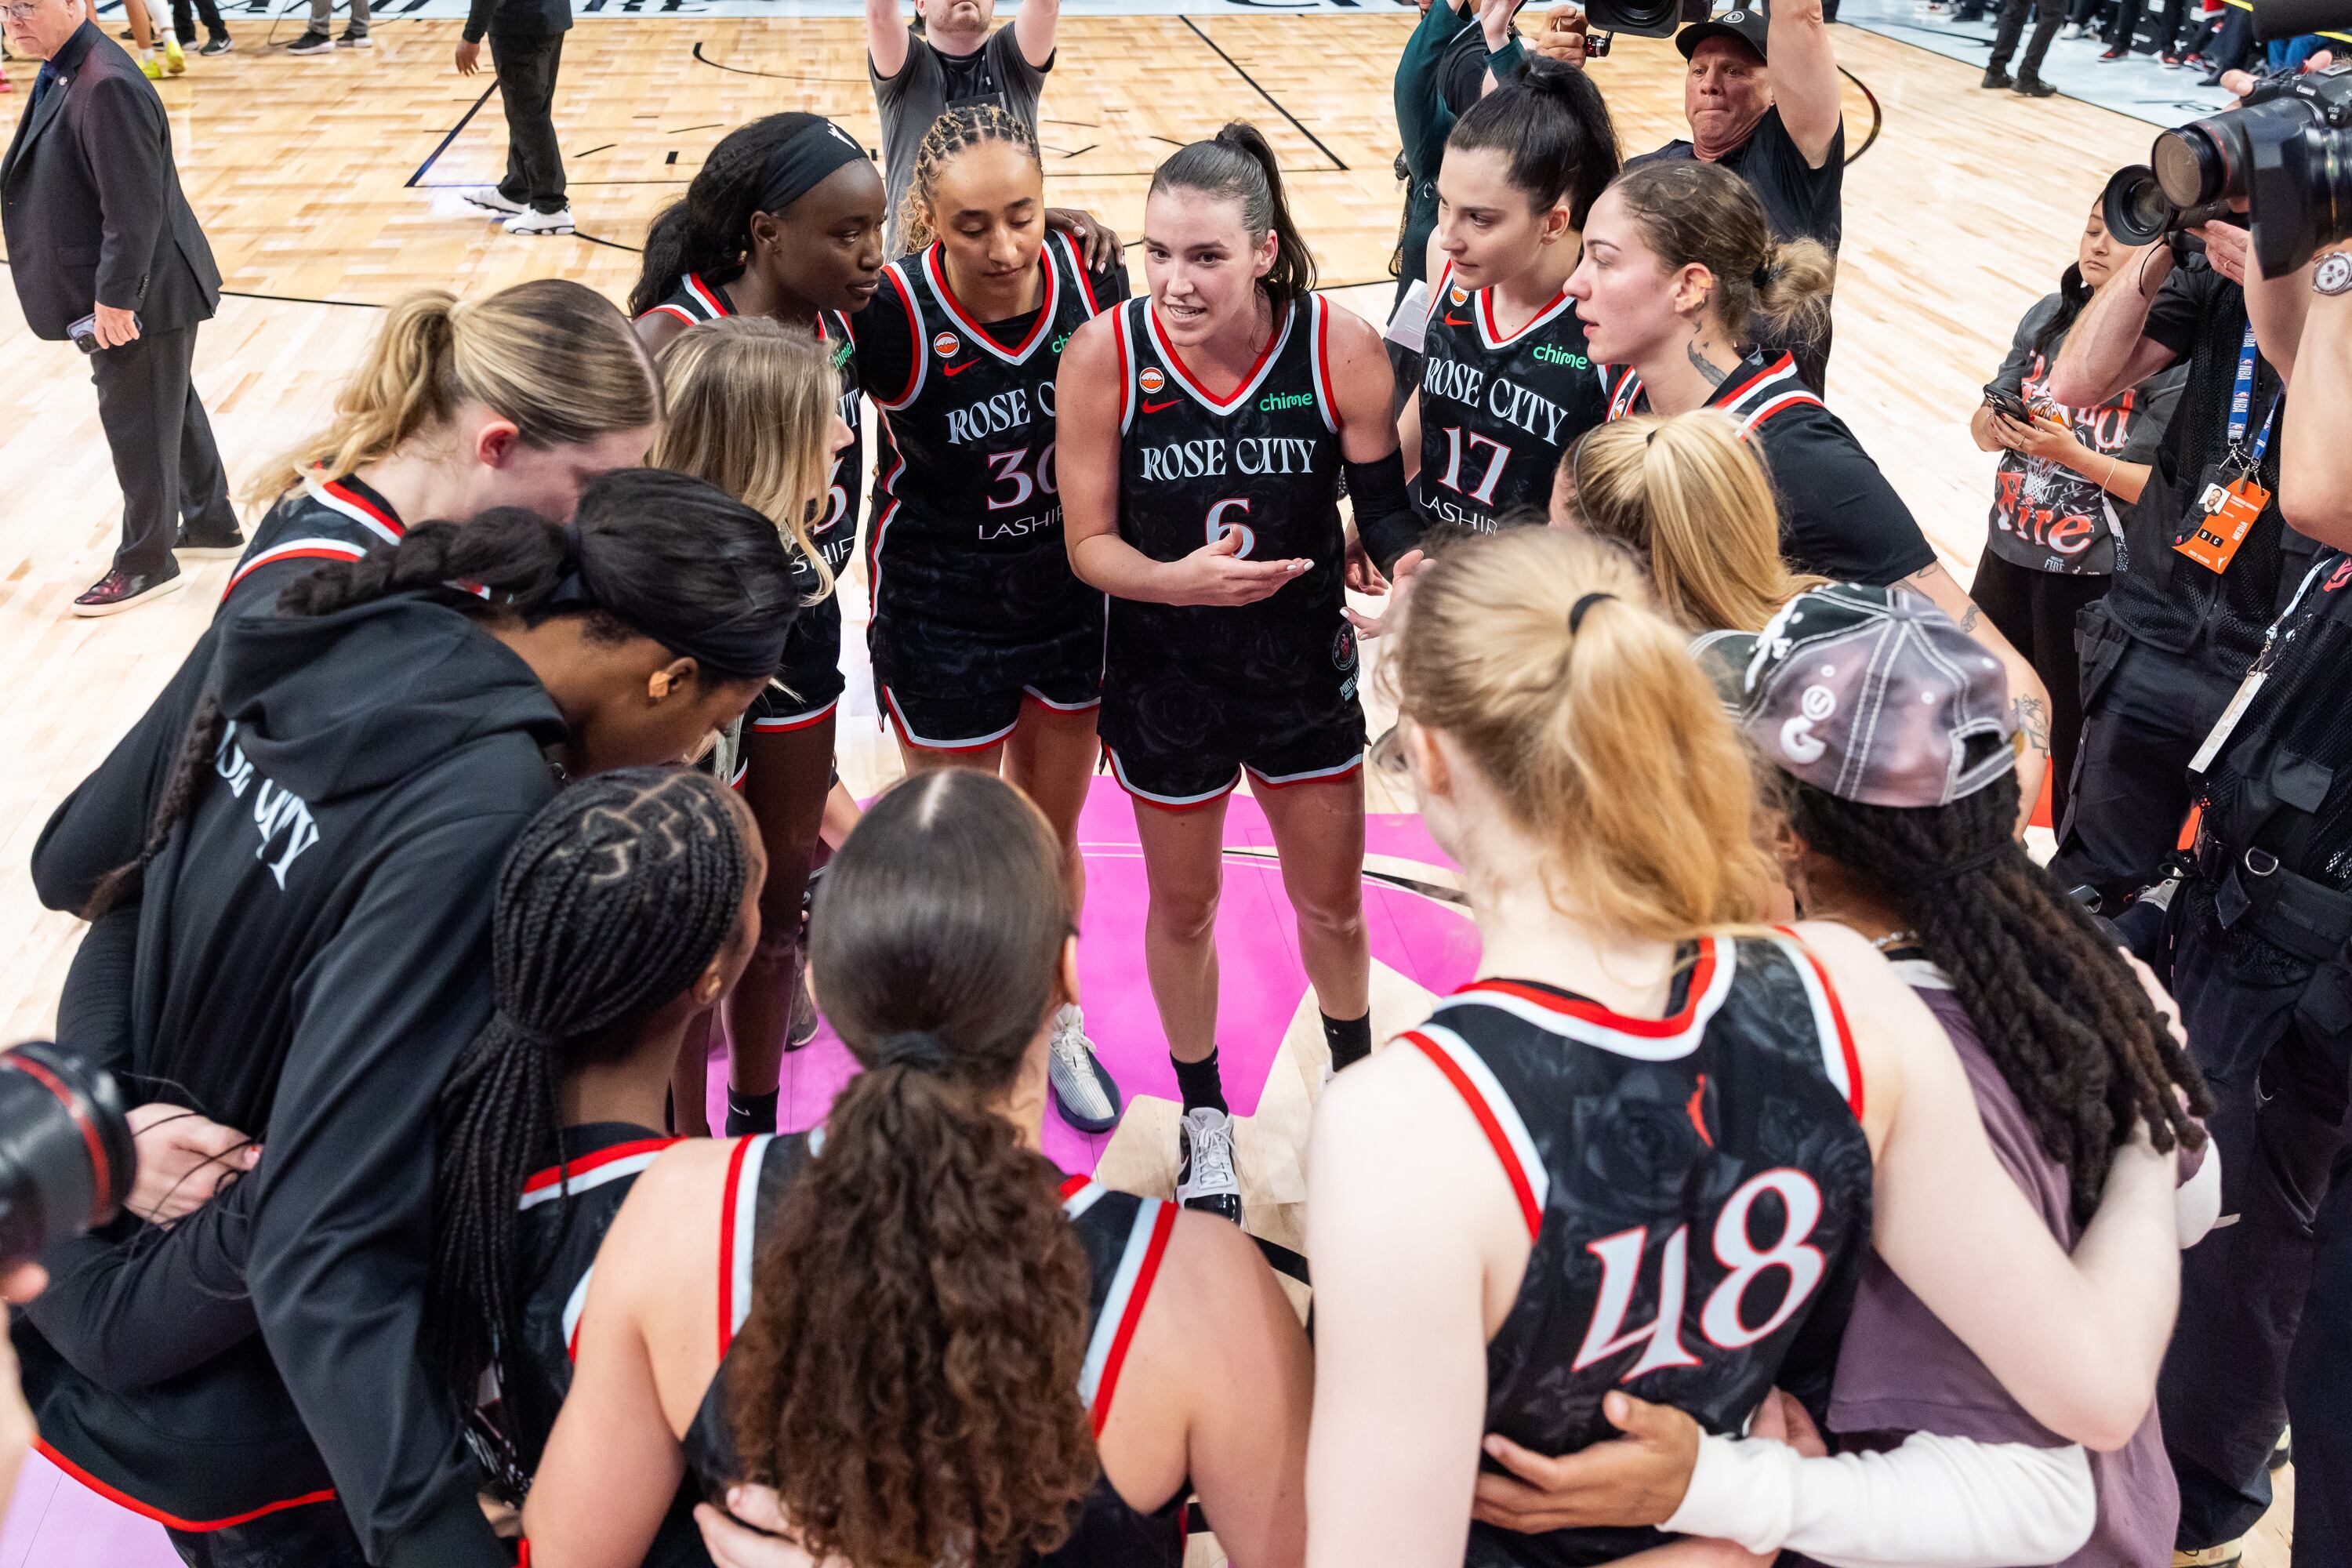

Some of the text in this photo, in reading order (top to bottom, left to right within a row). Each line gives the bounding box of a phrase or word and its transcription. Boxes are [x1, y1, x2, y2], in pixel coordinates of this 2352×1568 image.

[2296, 85, 2316, 96] Canon
[833, 341, 853, 369] hime
[1051, 332, 1072, 354] chi
[1533, 343, 1588, 370] chime
[2238, 365, 2252, 380] NBA
[1259, 392, 1313, 412] chime
[1423, 357, 1568, 446] ROSE CITY
[2232, 398, 2248, 413] NBA
[945, 389, 1031, 445] ROSE
[1140, 437, 1317, 481] ROSE CITY
[1438, 426, 1512, 506] 17
[1998, 472, 2092, 554] Fire
[1205, 498, 1255, 560] 6
[2231, 521, 2249, 542] MEDIA
[1571, 1167, 1827, 1385] 48
